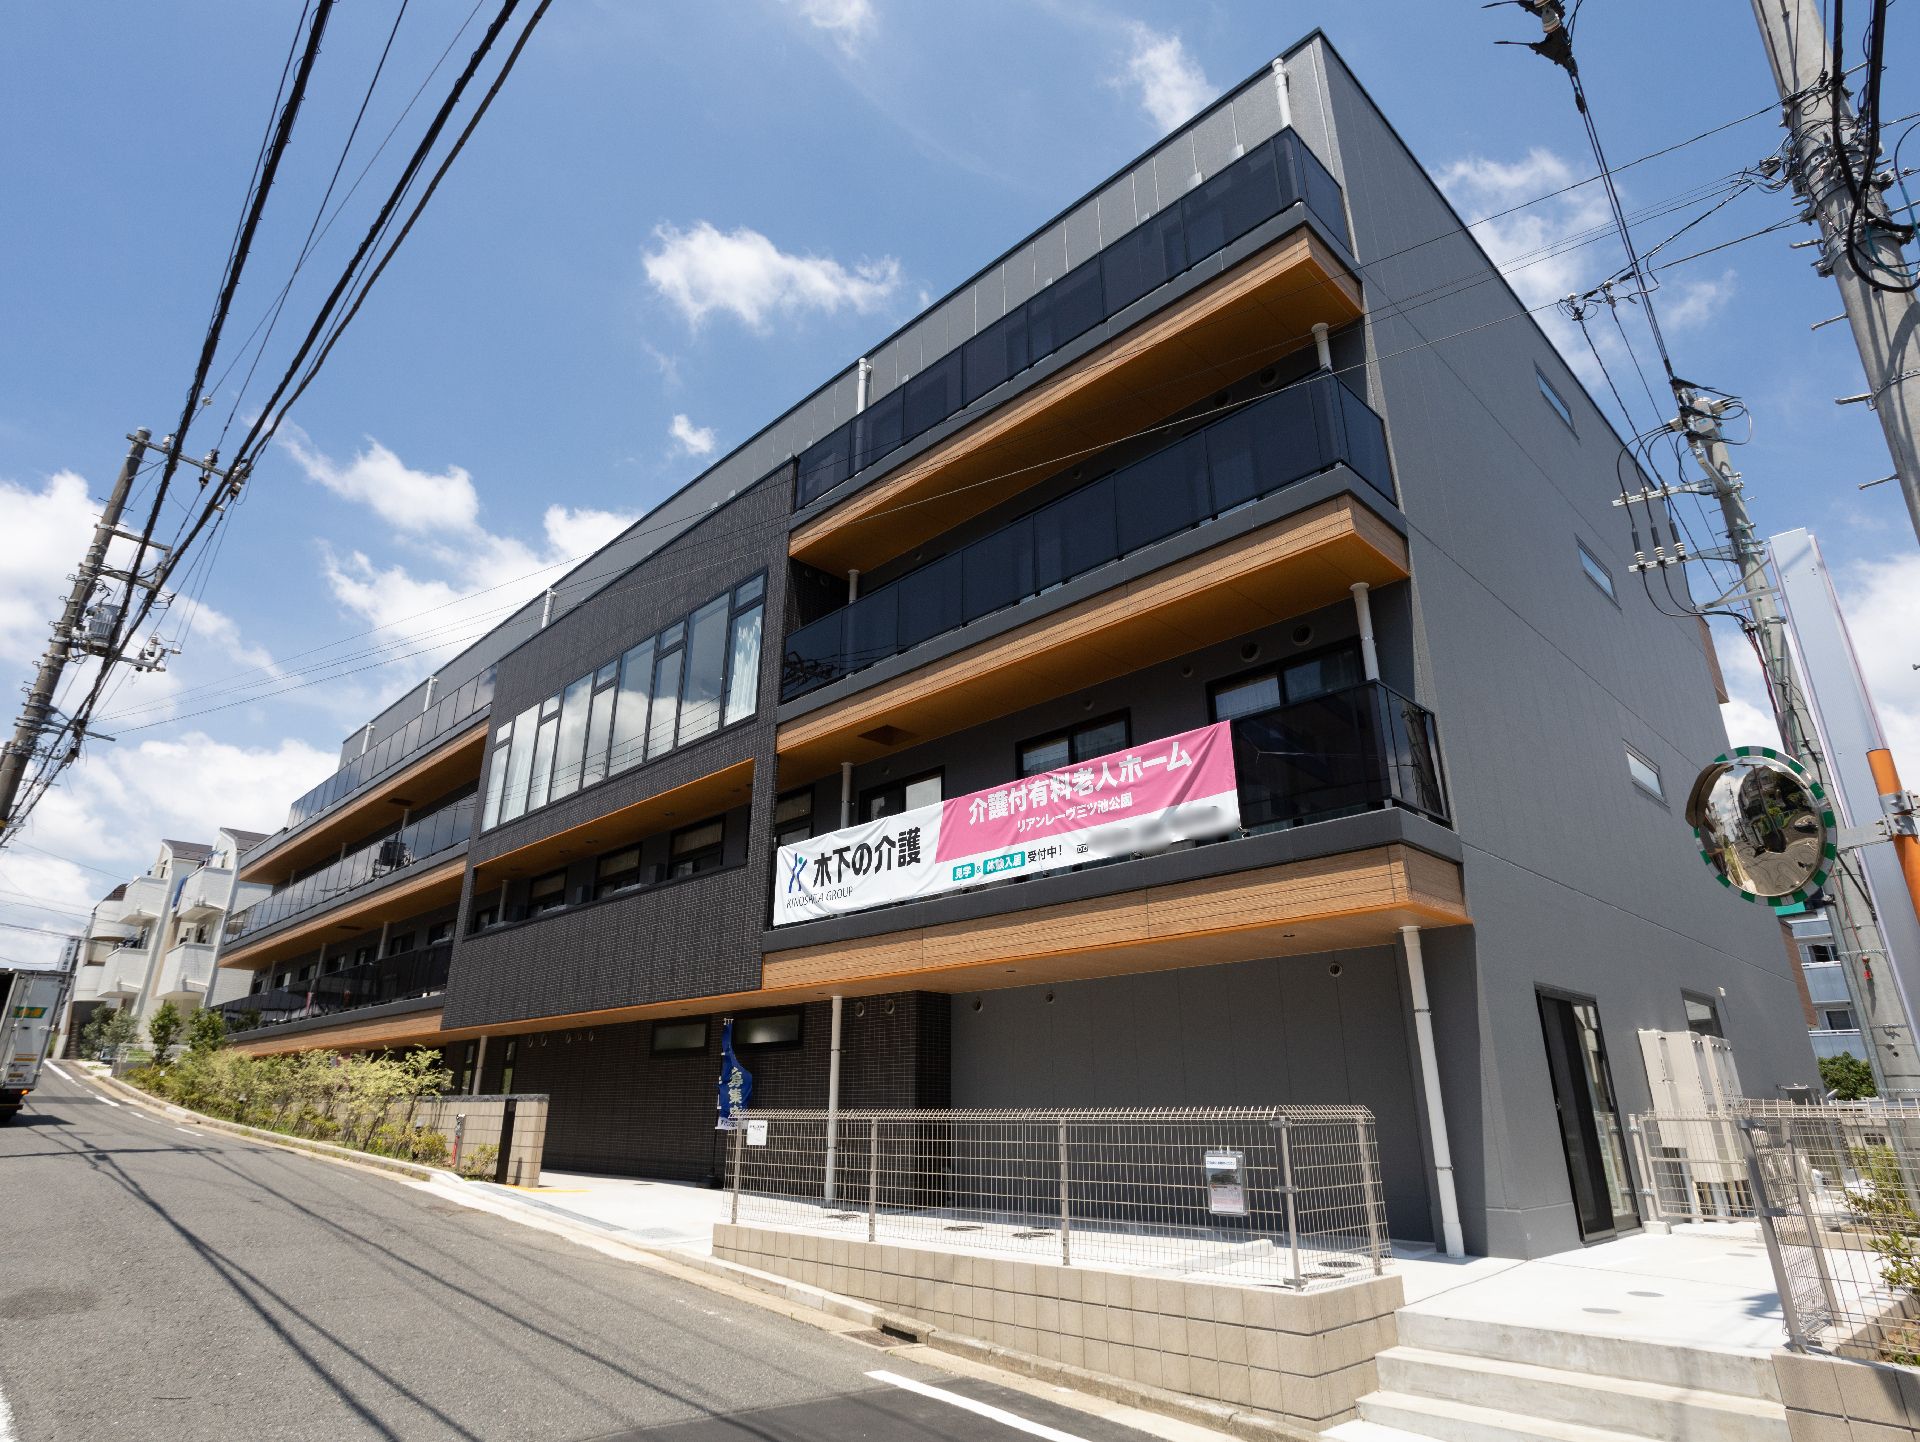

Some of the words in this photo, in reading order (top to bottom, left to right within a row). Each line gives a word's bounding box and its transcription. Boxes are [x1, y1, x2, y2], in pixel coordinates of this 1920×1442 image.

[968, 741, 1193, 826] 介護付有料老人ホーム
[812, 826, 921, 888] 木下の介護
[954, 865, 972, 879] 見学
[826, 886, 854, 901] GROUP
